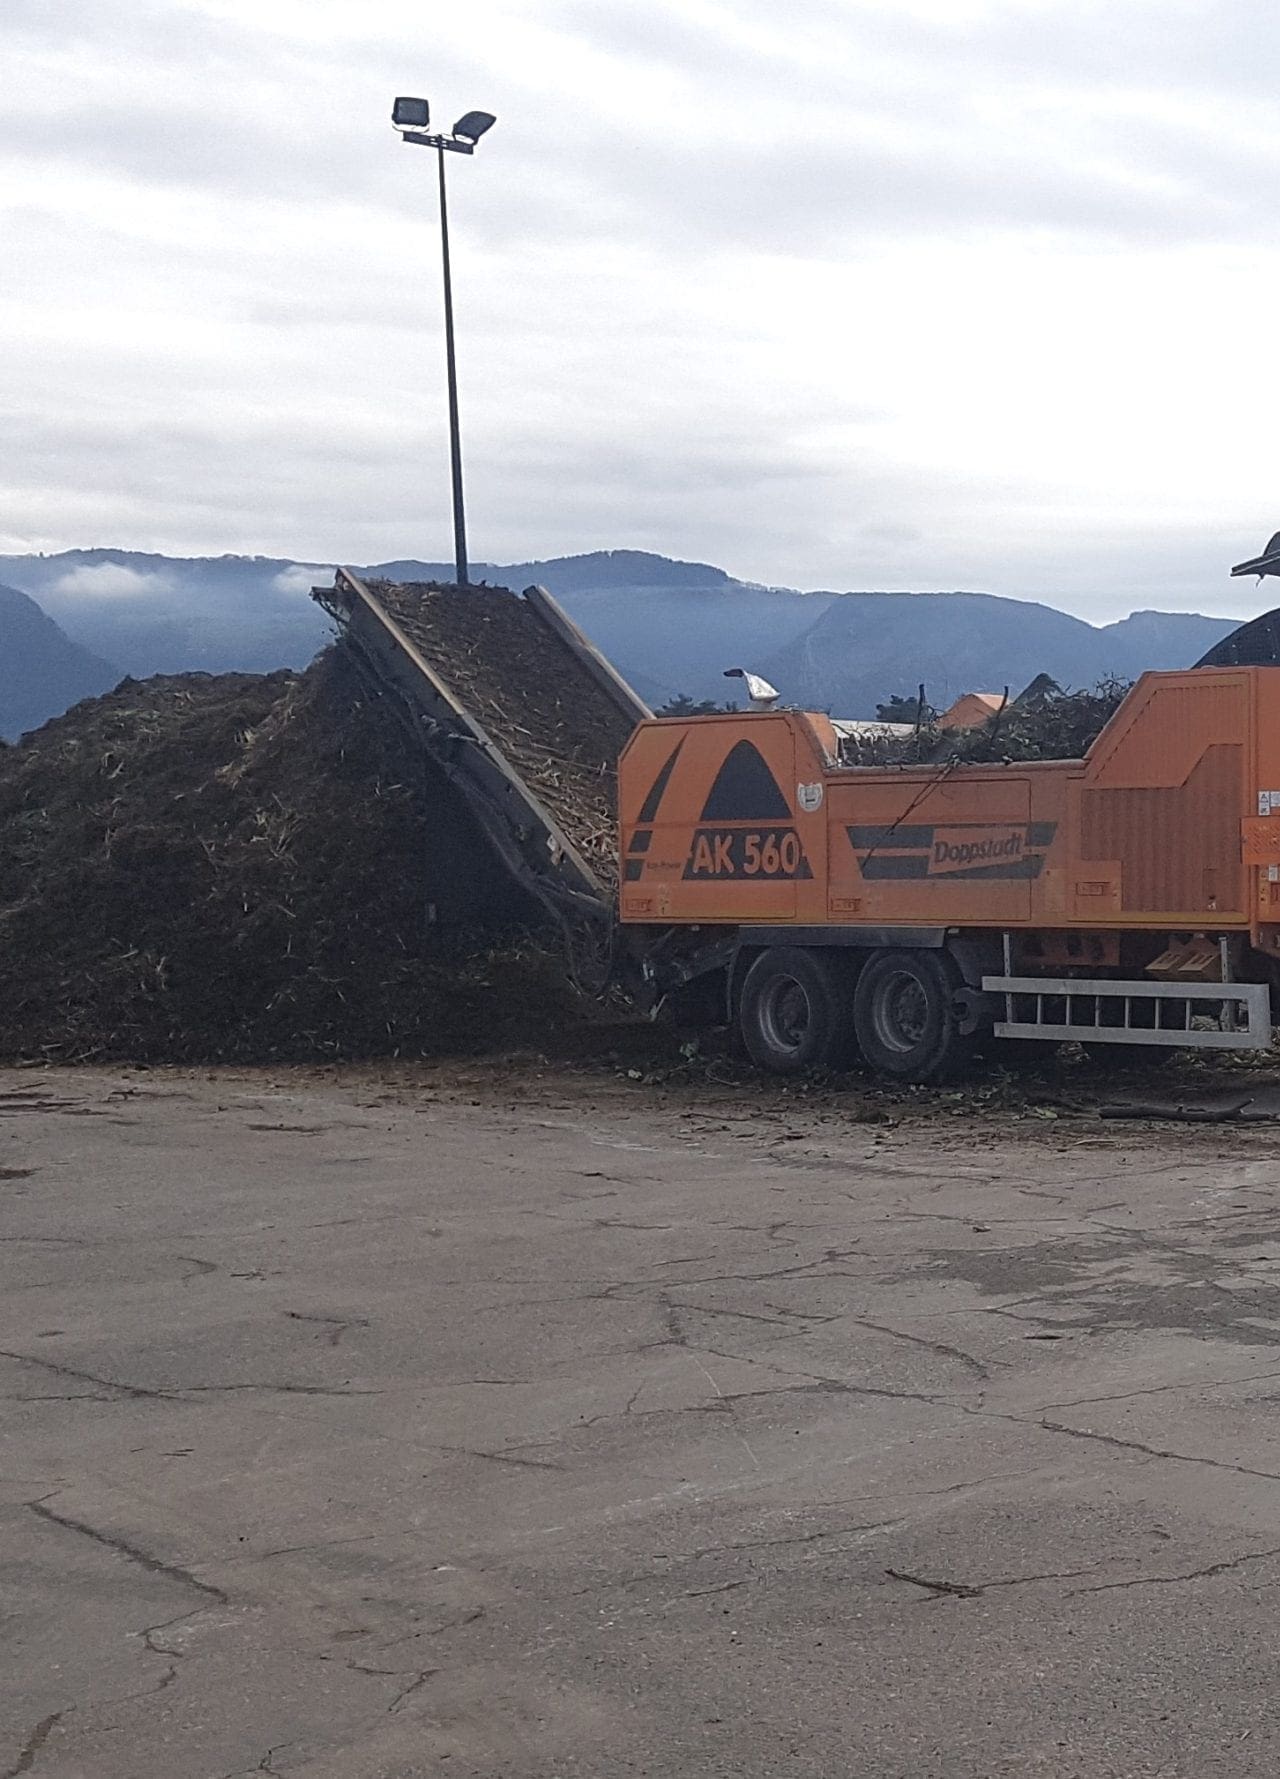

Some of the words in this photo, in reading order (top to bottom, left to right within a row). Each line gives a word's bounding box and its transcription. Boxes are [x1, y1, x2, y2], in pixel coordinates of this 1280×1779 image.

[692, 834, 735, 874] AK
[743, 831, 800, 874] 560
[934, 831, 1023, 864] Doppstadt
